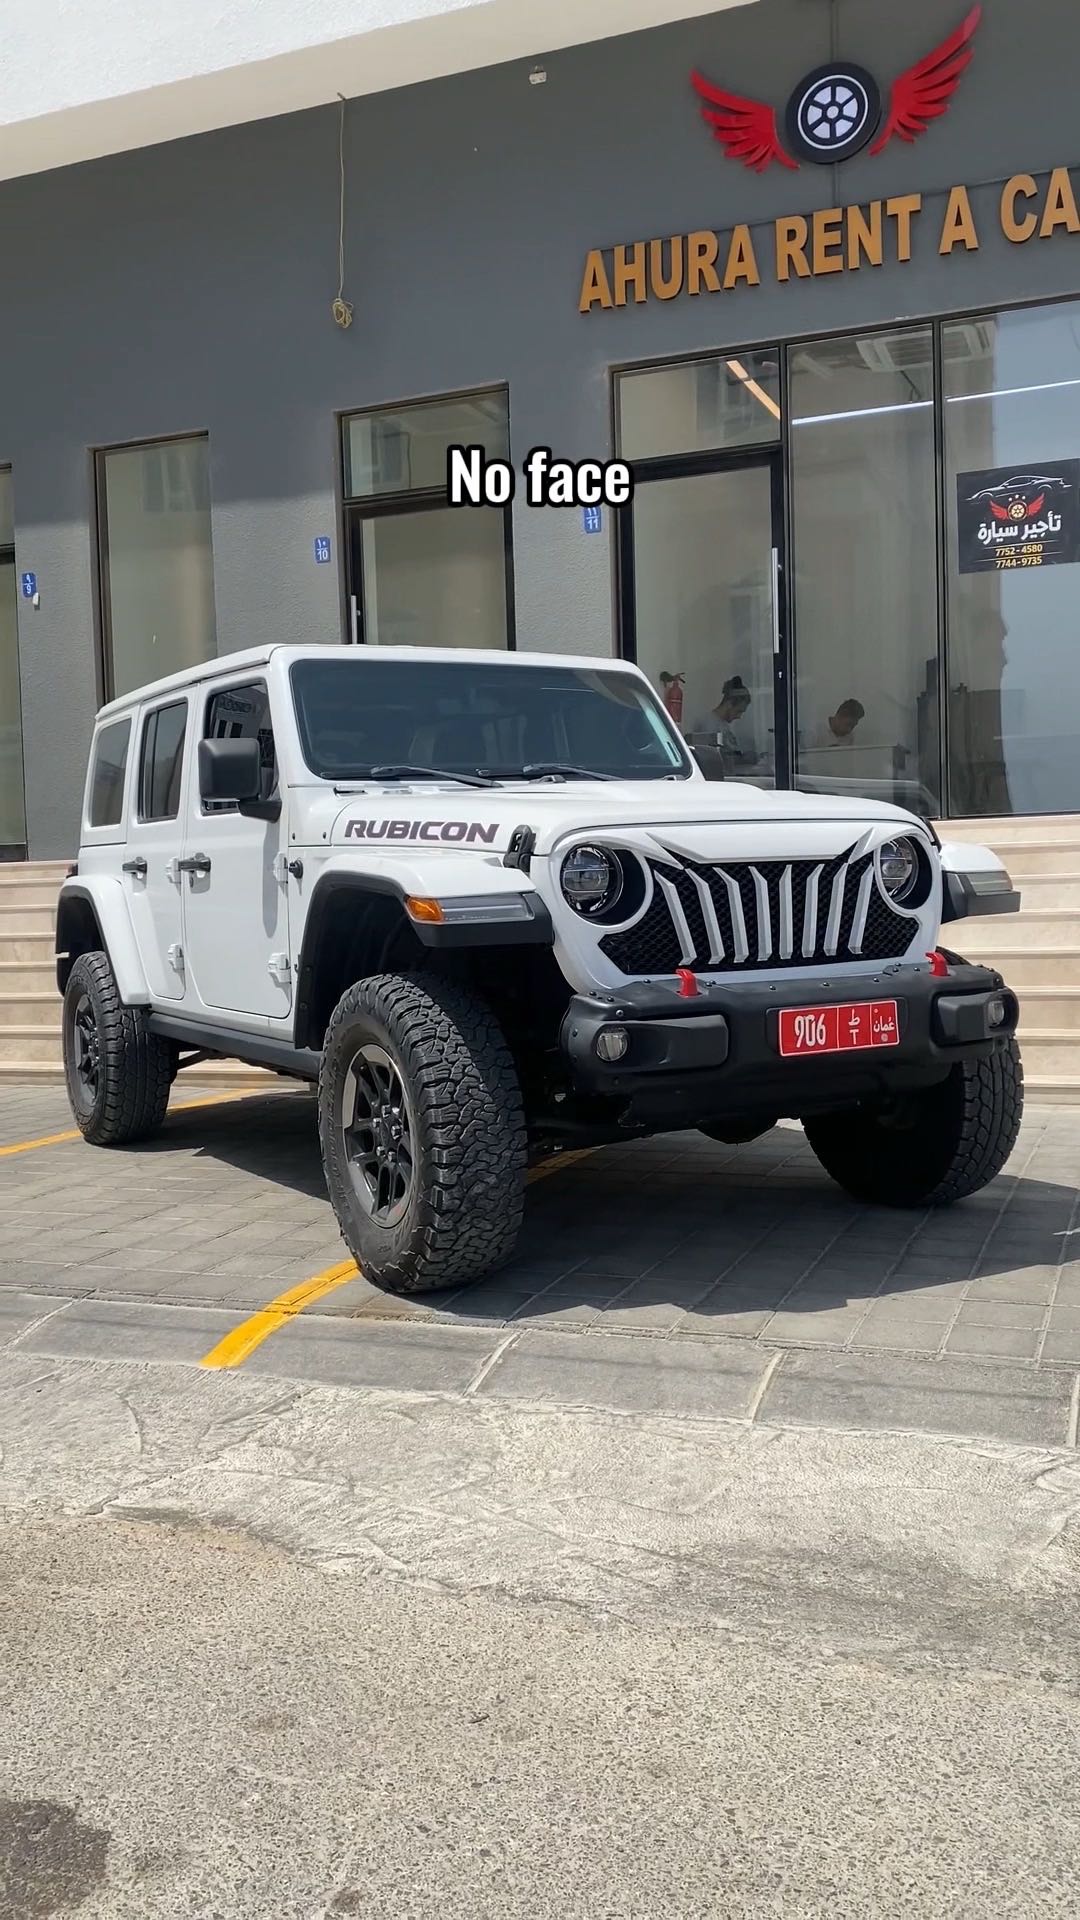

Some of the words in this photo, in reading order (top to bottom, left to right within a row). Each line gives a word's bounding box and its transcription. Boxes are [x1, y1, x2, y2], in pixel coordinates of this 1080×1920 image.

[578, 223, 761, 313] AHURA
[775, 193, 922, 282] RENT
[938, 185, 980, 255] A
[587, 518, 598, 530] 11
[977, 520, 1018, 545] سيارة
[1020, 511, 1061, 540] تأجير
[316, 549, 328, 561] 10
[344, 819, 500, 844] RUBICON
[848, 1008, 860, 1026] ط
[849, 1029, 859, 1045] T
